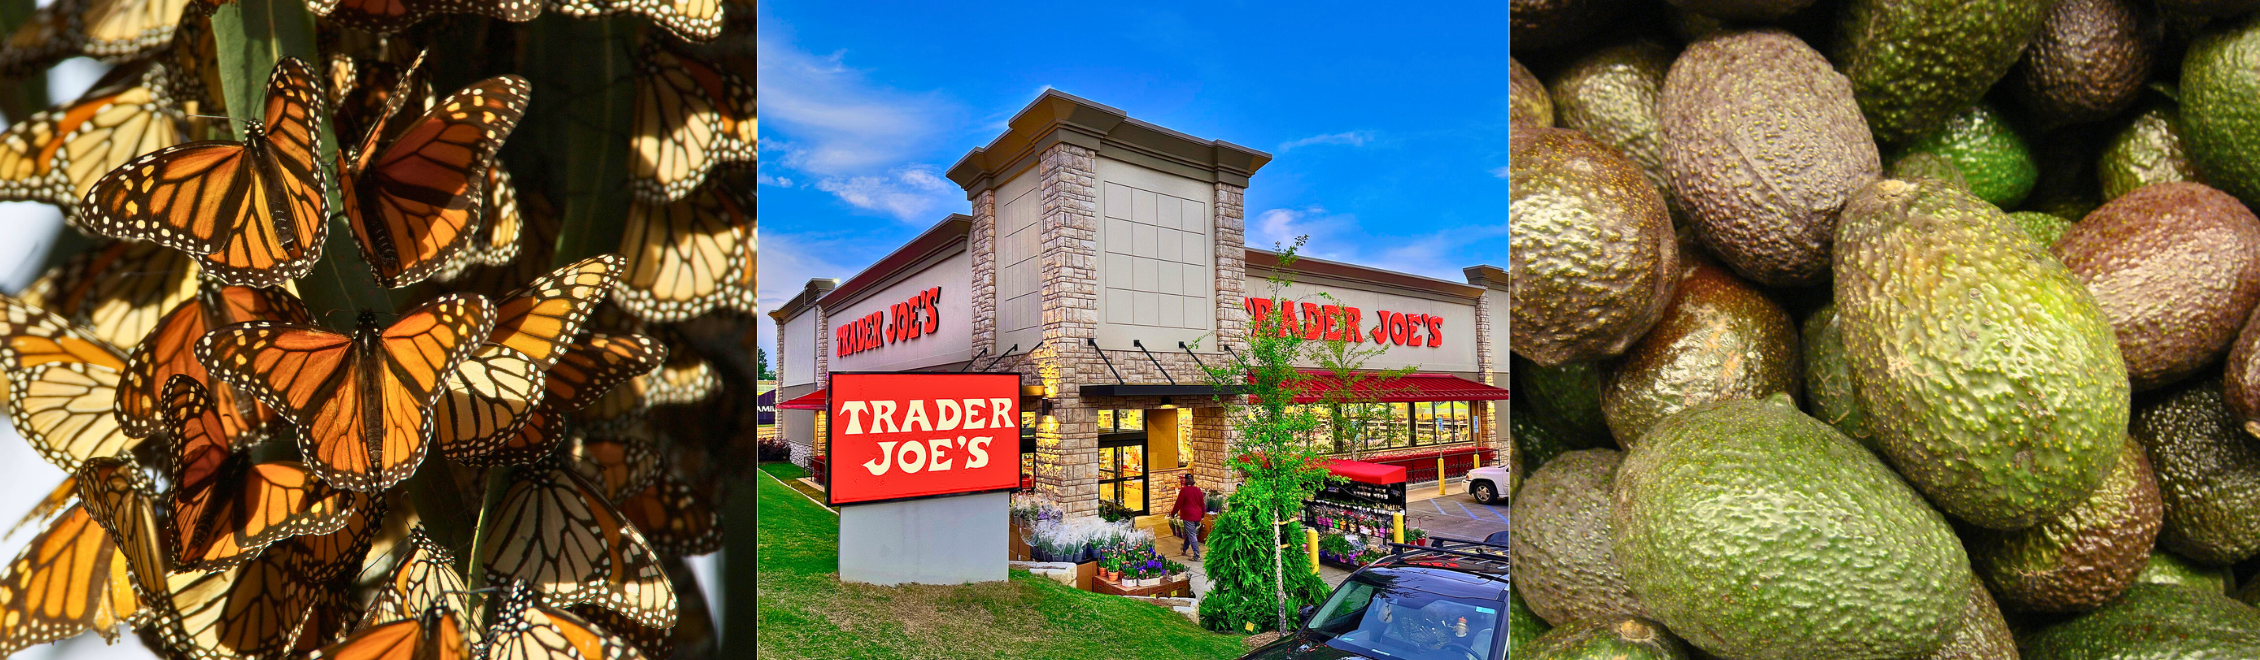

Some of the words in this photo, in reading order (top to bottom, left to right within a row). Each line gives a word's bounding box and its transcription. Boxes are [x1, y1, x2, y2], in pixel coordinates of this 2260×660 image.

[836, 311, 884, 357] TRADER
[885, 286, 941, 344] JOE'S
[1369, 310, 1444, 348] JOE'S
[839, 398, 1015, 435] TRADER
[862, 435, 993, 476] JOE'S
